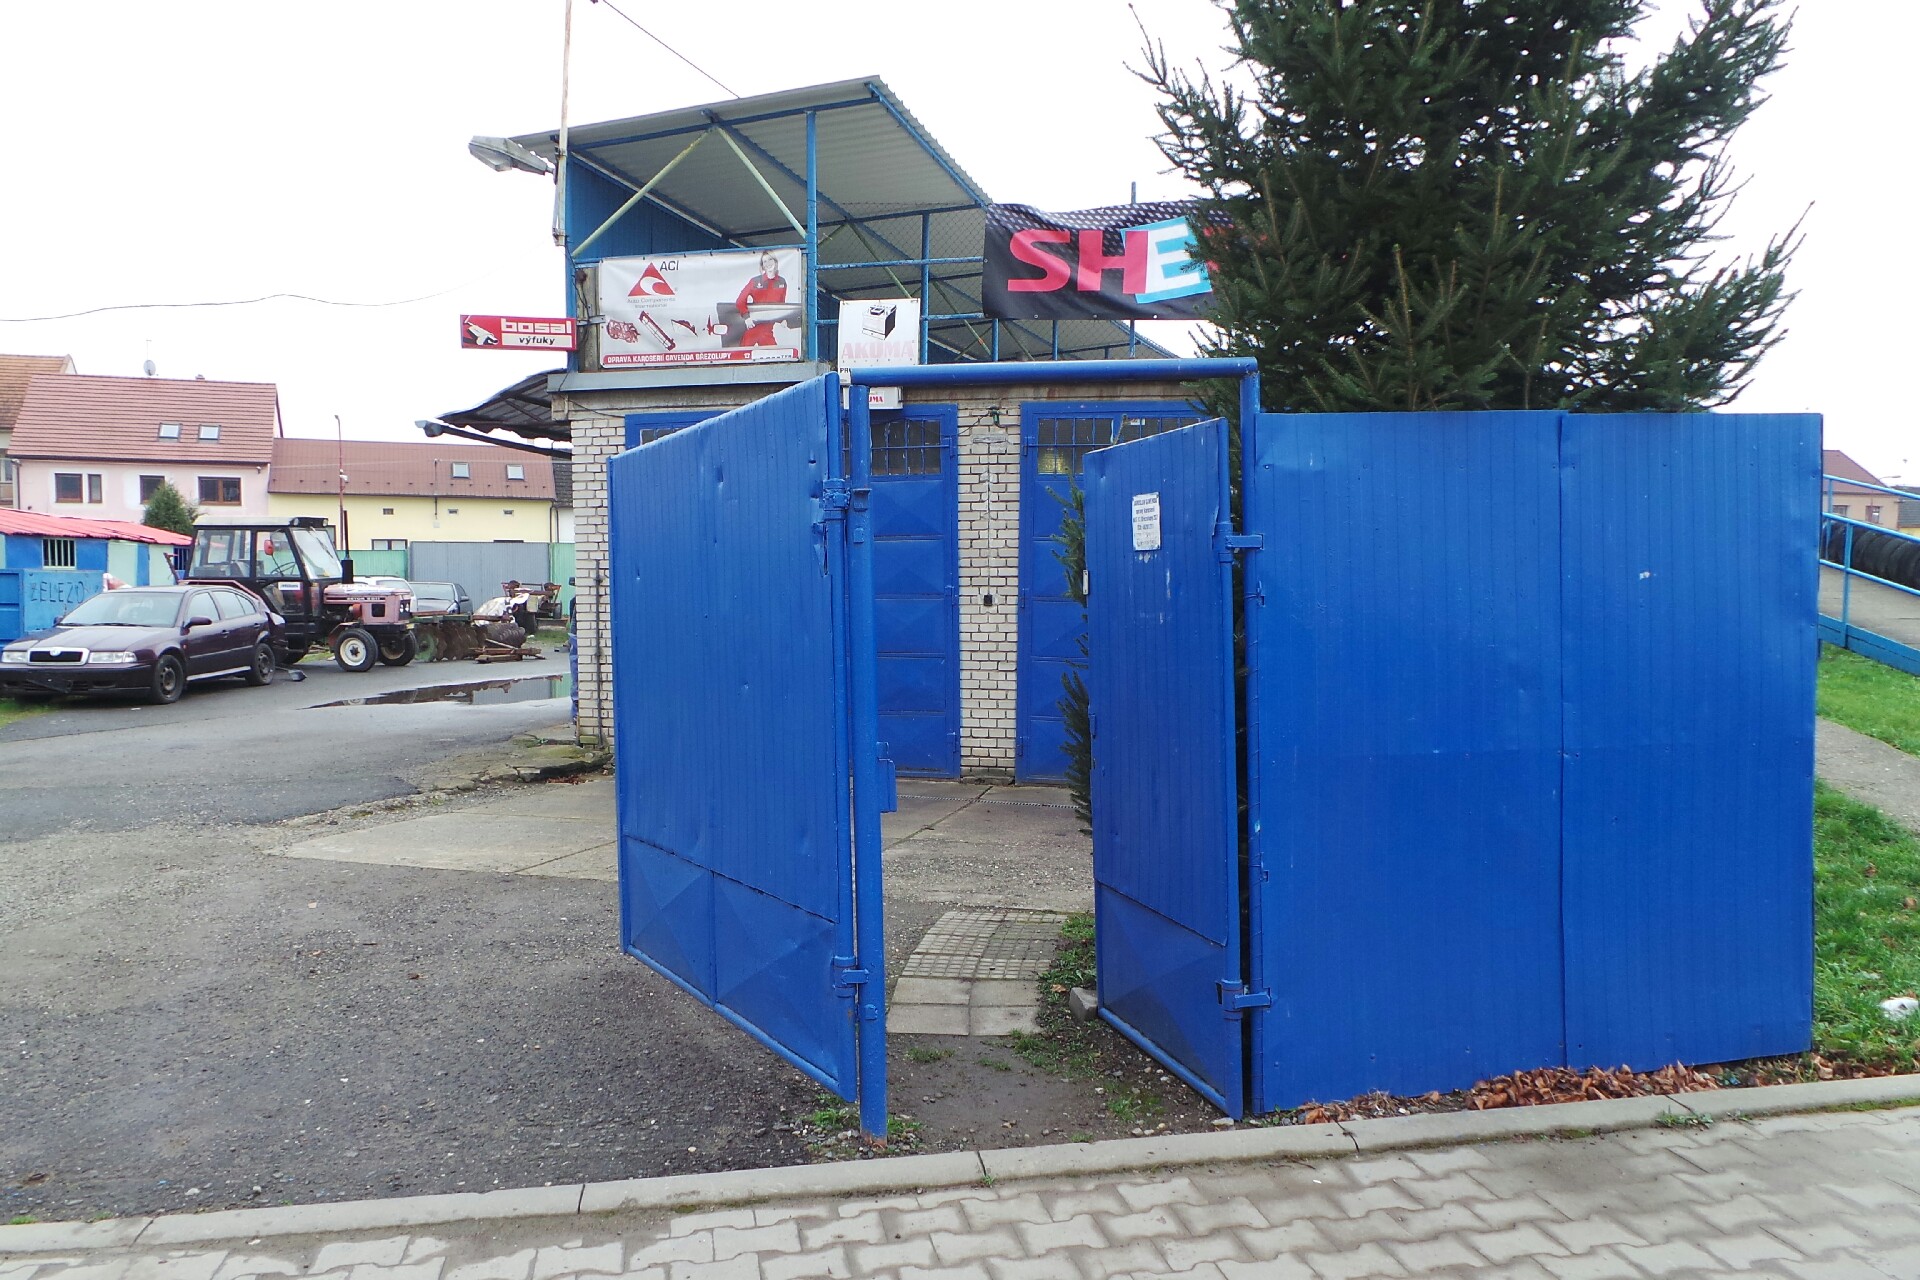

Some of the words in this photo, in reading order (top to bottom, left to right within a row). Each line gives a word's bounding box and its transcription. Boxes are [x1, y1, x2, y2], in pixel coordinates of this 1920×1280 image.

[659, 260, 680, 271] ACI
[500, 317, 572, 334] bosal
[519, 335, 556, 346] výfuky
[841, 340, 915, 359] AKUMA
[607, 355, 632, 364] OPRAVA
[665, 353, 695, 362] GAVENDA
